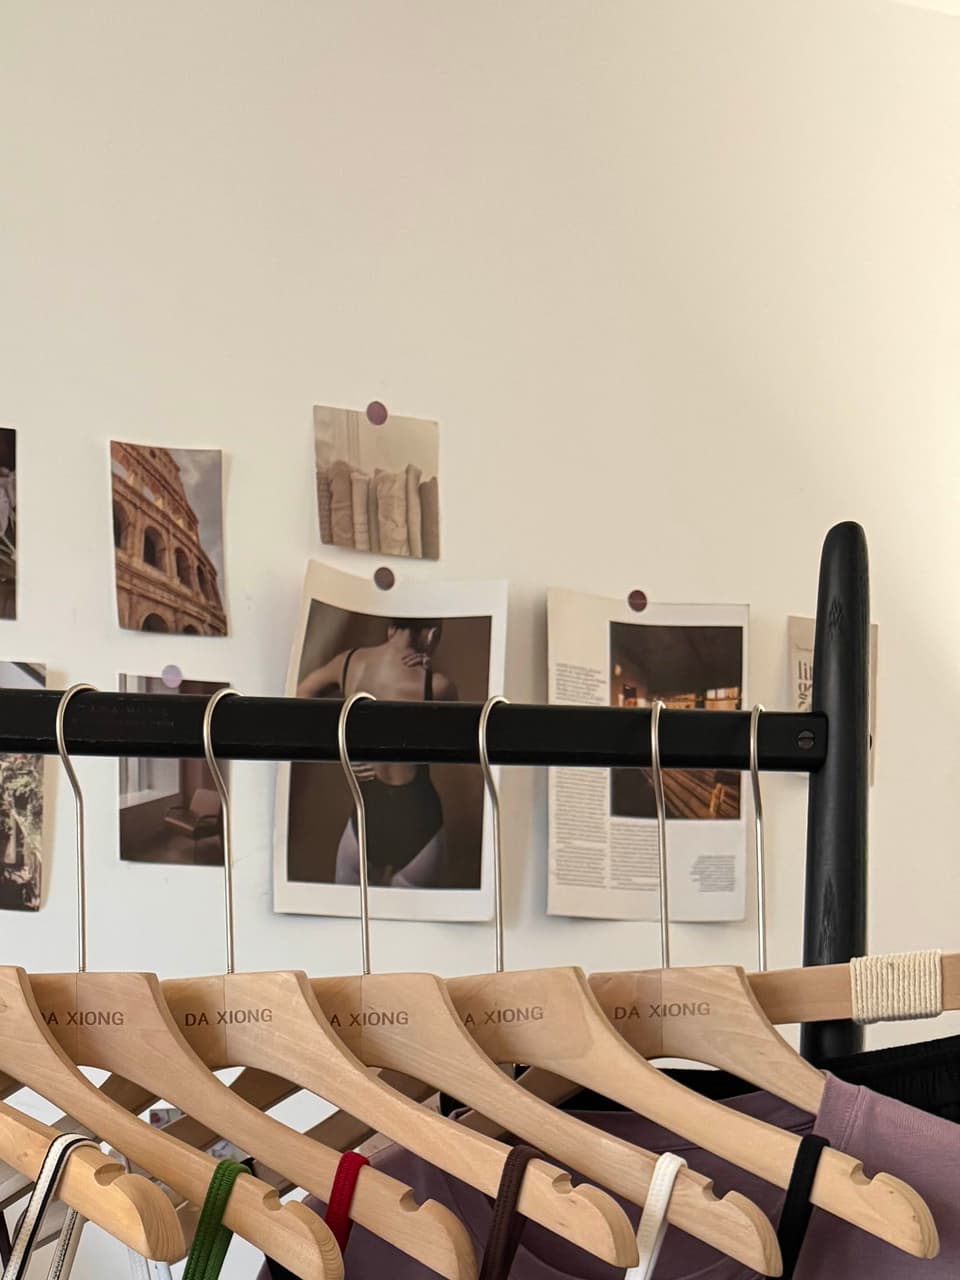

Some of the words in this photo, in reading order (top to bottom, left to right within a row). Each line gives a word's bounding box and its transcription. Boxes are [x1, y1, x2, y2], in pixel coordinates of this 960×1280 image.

[41, 1013, 59, 1026] A
[66, 1010, 125, 1026] XIONG
[184, 1012, 209, 1027] DA
[216, 1008, 273, 1026] XIONG
[329, 1014, 341, 1027] A
[349, 1010, 409, 1026] XIONG
[463, 1012, 476, 1027] A
[483, 1006, 545, 1026] XIONG
[614, 1006, 640, 1021] DA
[648, 1002, 711, 1019] XIONG
